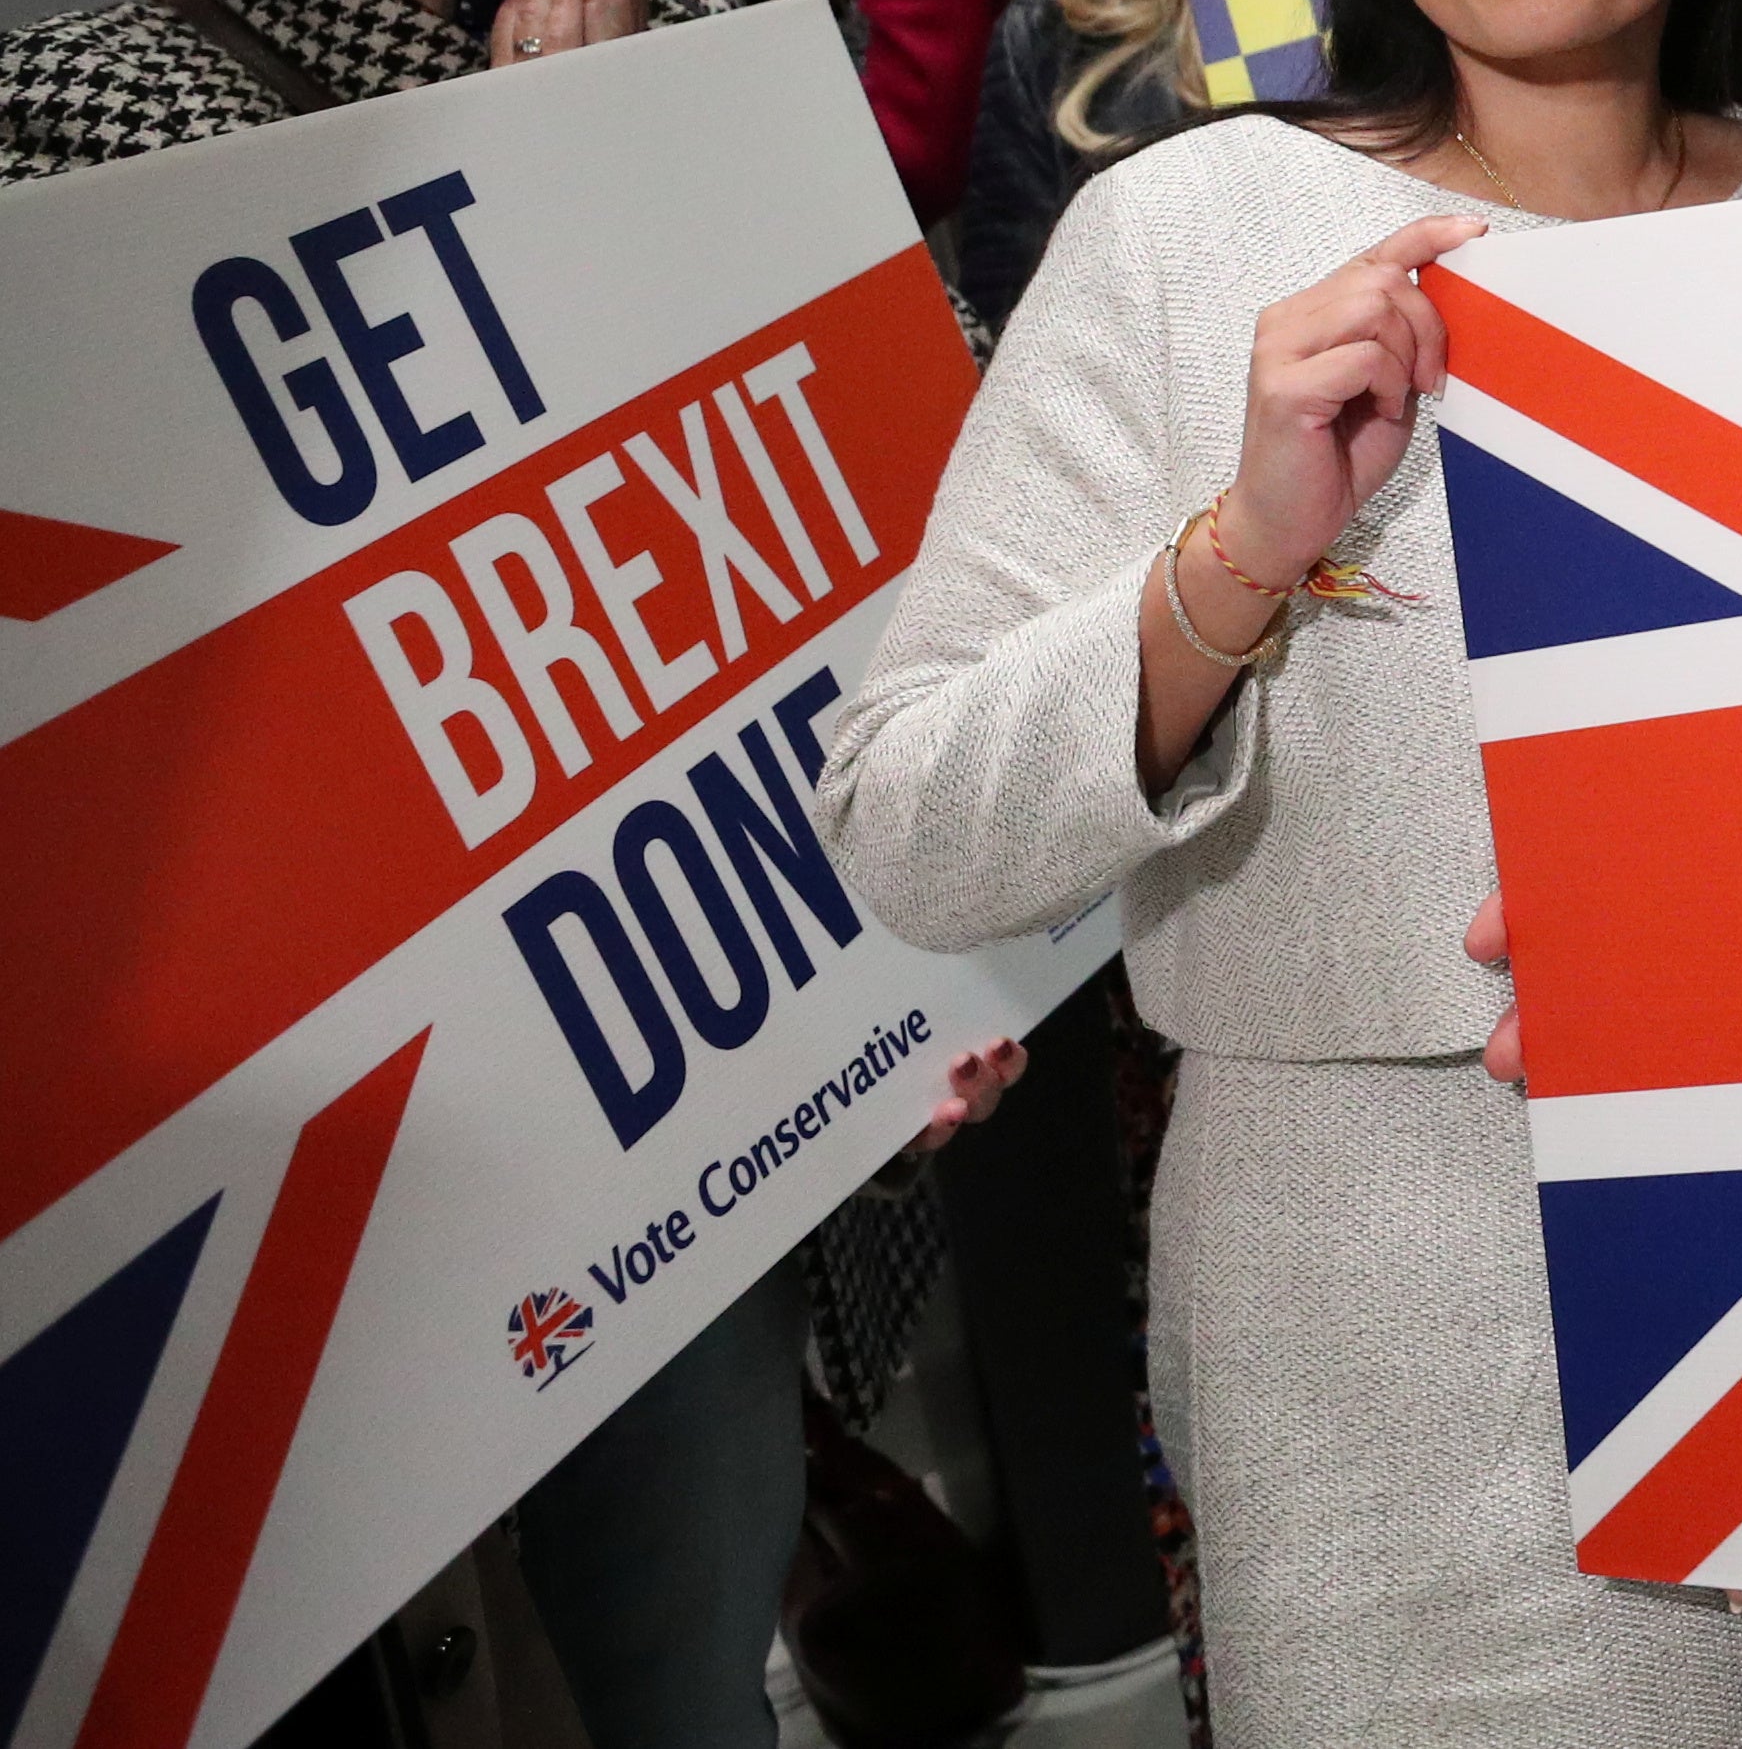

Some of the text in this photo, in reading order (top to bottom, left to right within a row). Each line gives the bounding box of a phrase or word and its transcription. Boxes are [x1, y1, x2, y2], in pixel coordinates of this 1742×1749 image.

[192, 170, 546, 526] GET
[341, 340, 880, 851] BREXIT
[590, 1007, 932, 1304] Vote Conservative
